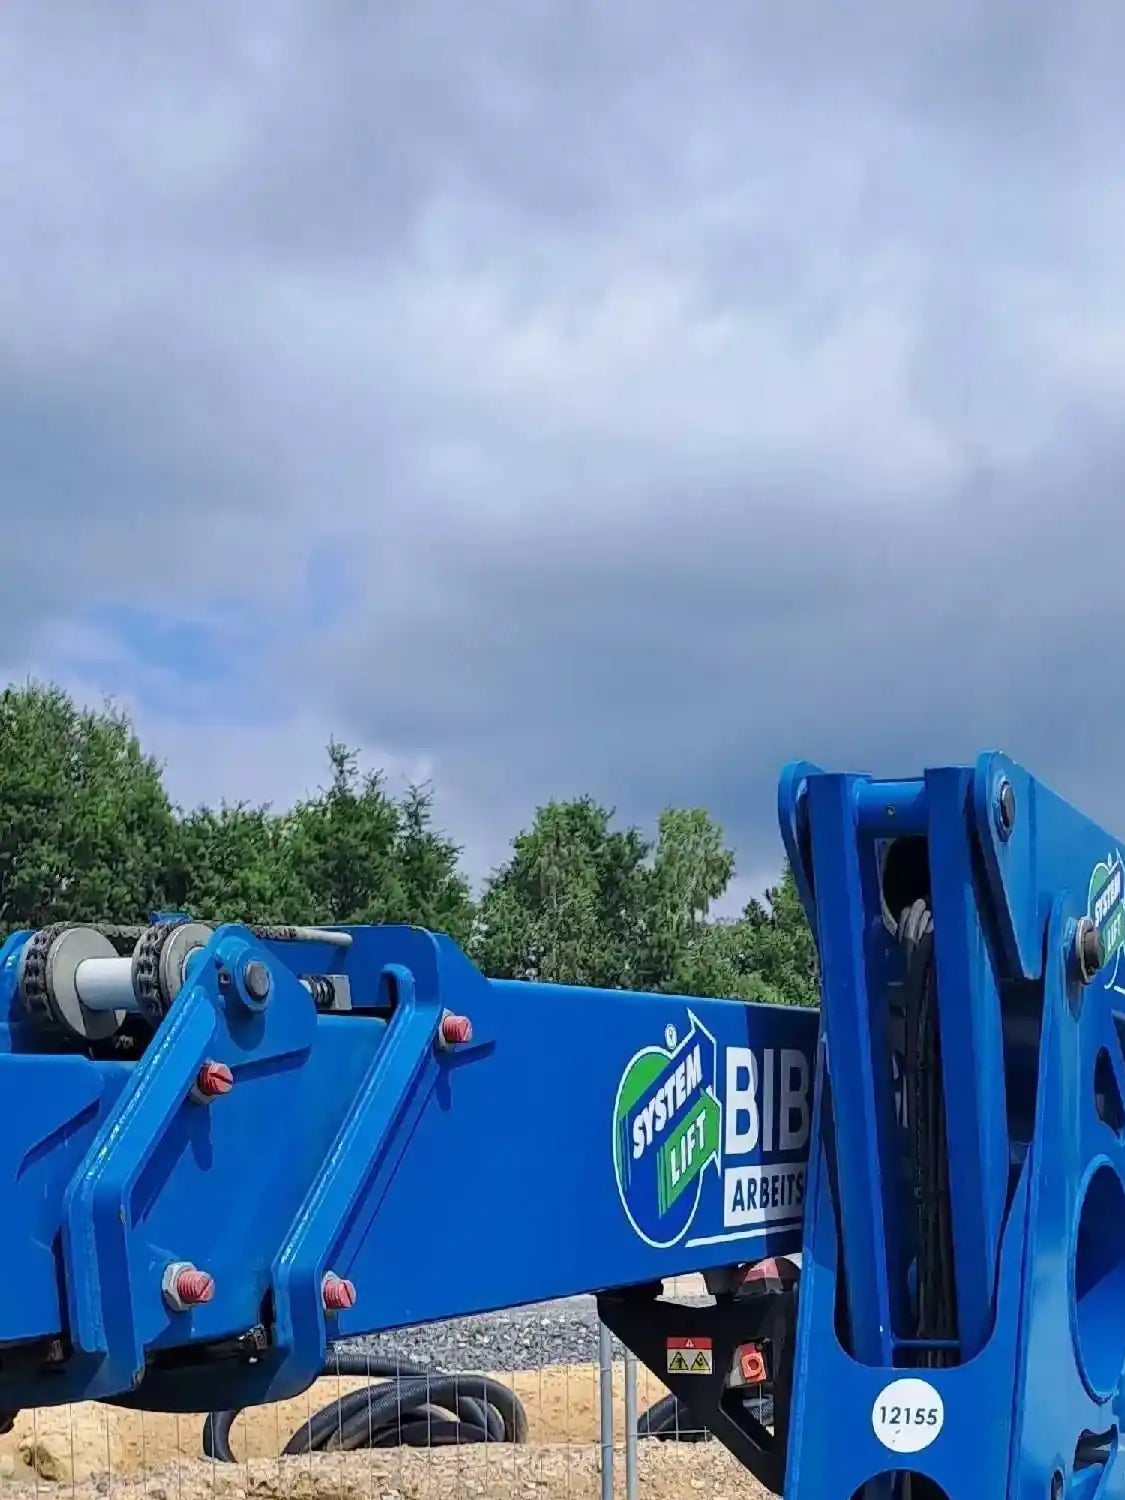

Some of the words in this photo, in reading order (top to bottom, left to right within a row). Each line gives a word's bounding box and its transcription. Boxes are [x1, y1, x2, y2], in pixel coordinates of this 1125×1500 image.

[632, 1044, 703, 1159] SYSTEM
[669, 1112, 706, 1186] LIFT
[879, 1405, 938, 1425] 12155
